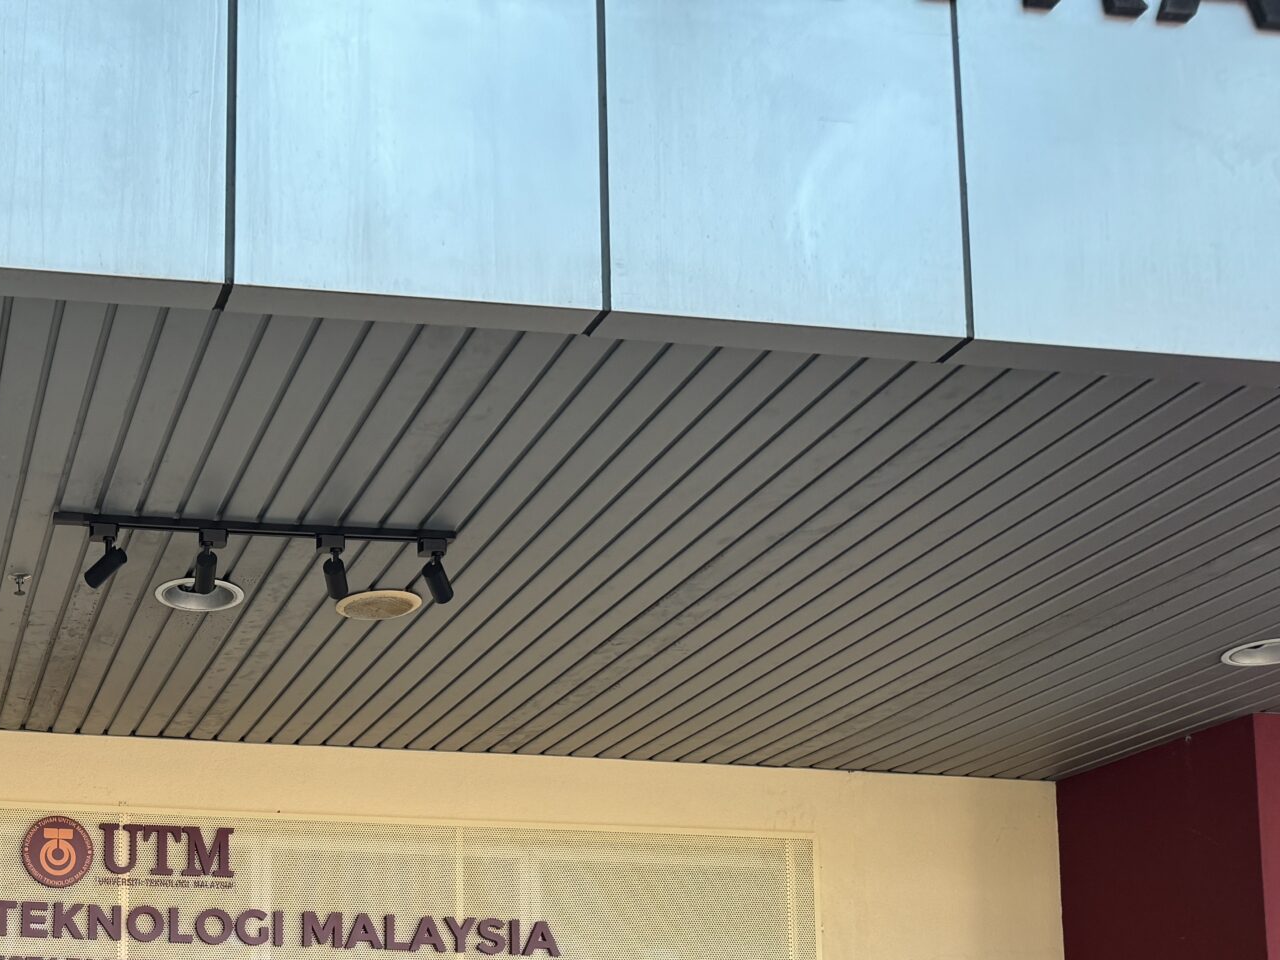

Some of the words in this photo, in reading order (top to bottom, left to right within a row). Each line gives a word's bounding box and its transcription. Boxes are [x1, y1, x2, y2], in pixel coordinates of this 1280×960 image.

[38, 817, 57, 827] TUHAN
[98, 823, 235, 878] UTM
[43, 877, 75, 886] TEKNOLOGI
[301, 910, 562, 957] MALAYSIA
